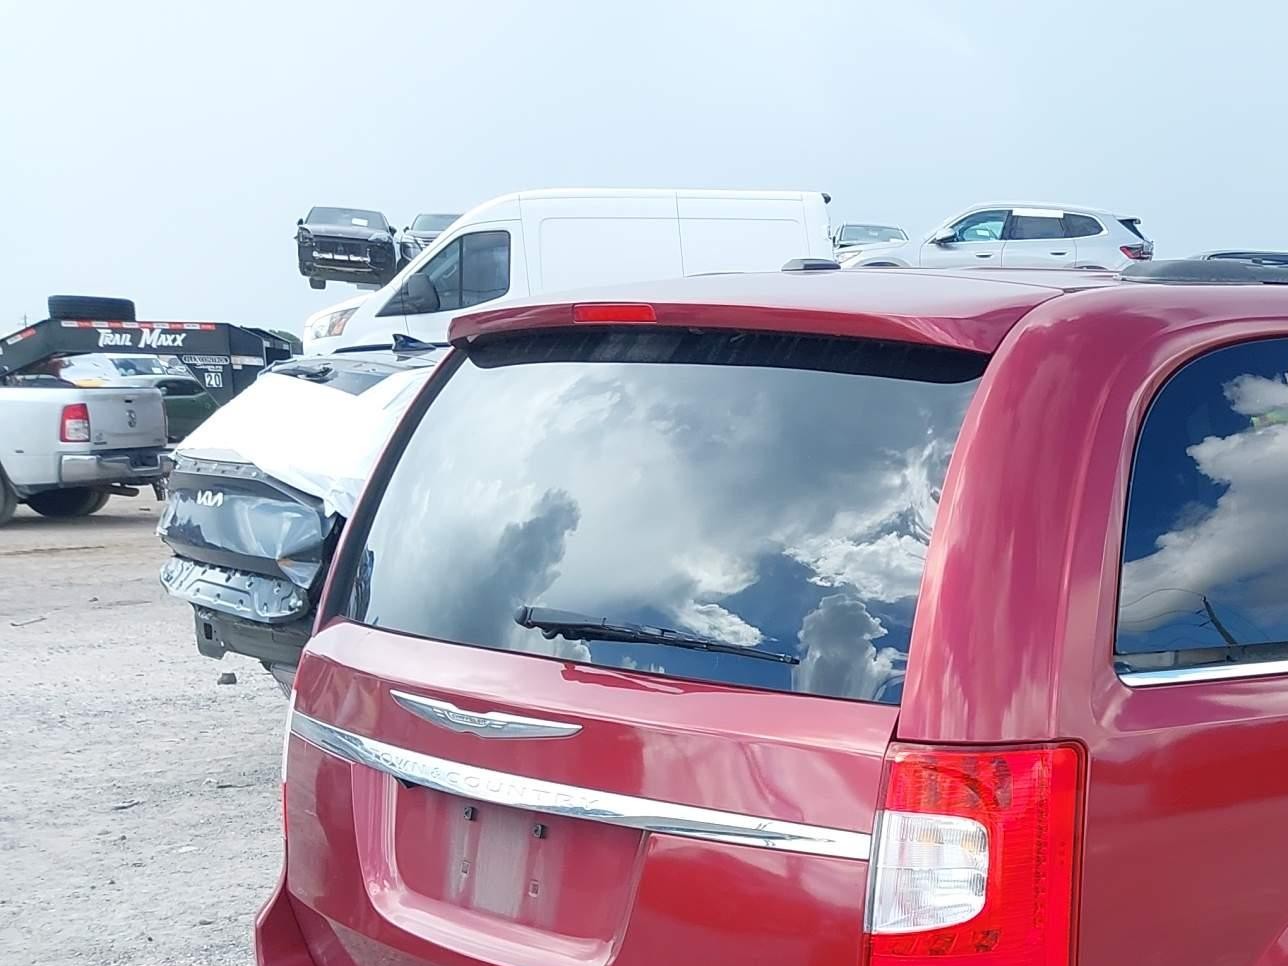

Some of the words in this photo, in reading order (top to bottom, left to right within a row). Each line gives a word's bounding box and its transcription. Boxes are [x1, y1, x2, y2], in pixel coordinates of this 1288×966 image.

[206, 373, 221, 387] 20
[196, 489, 224, 507] KIA
[369, 746, 427, 773] TOWN
[429, 766, 442, 779] &
[445, 771, 600, 810] COUNTRY
